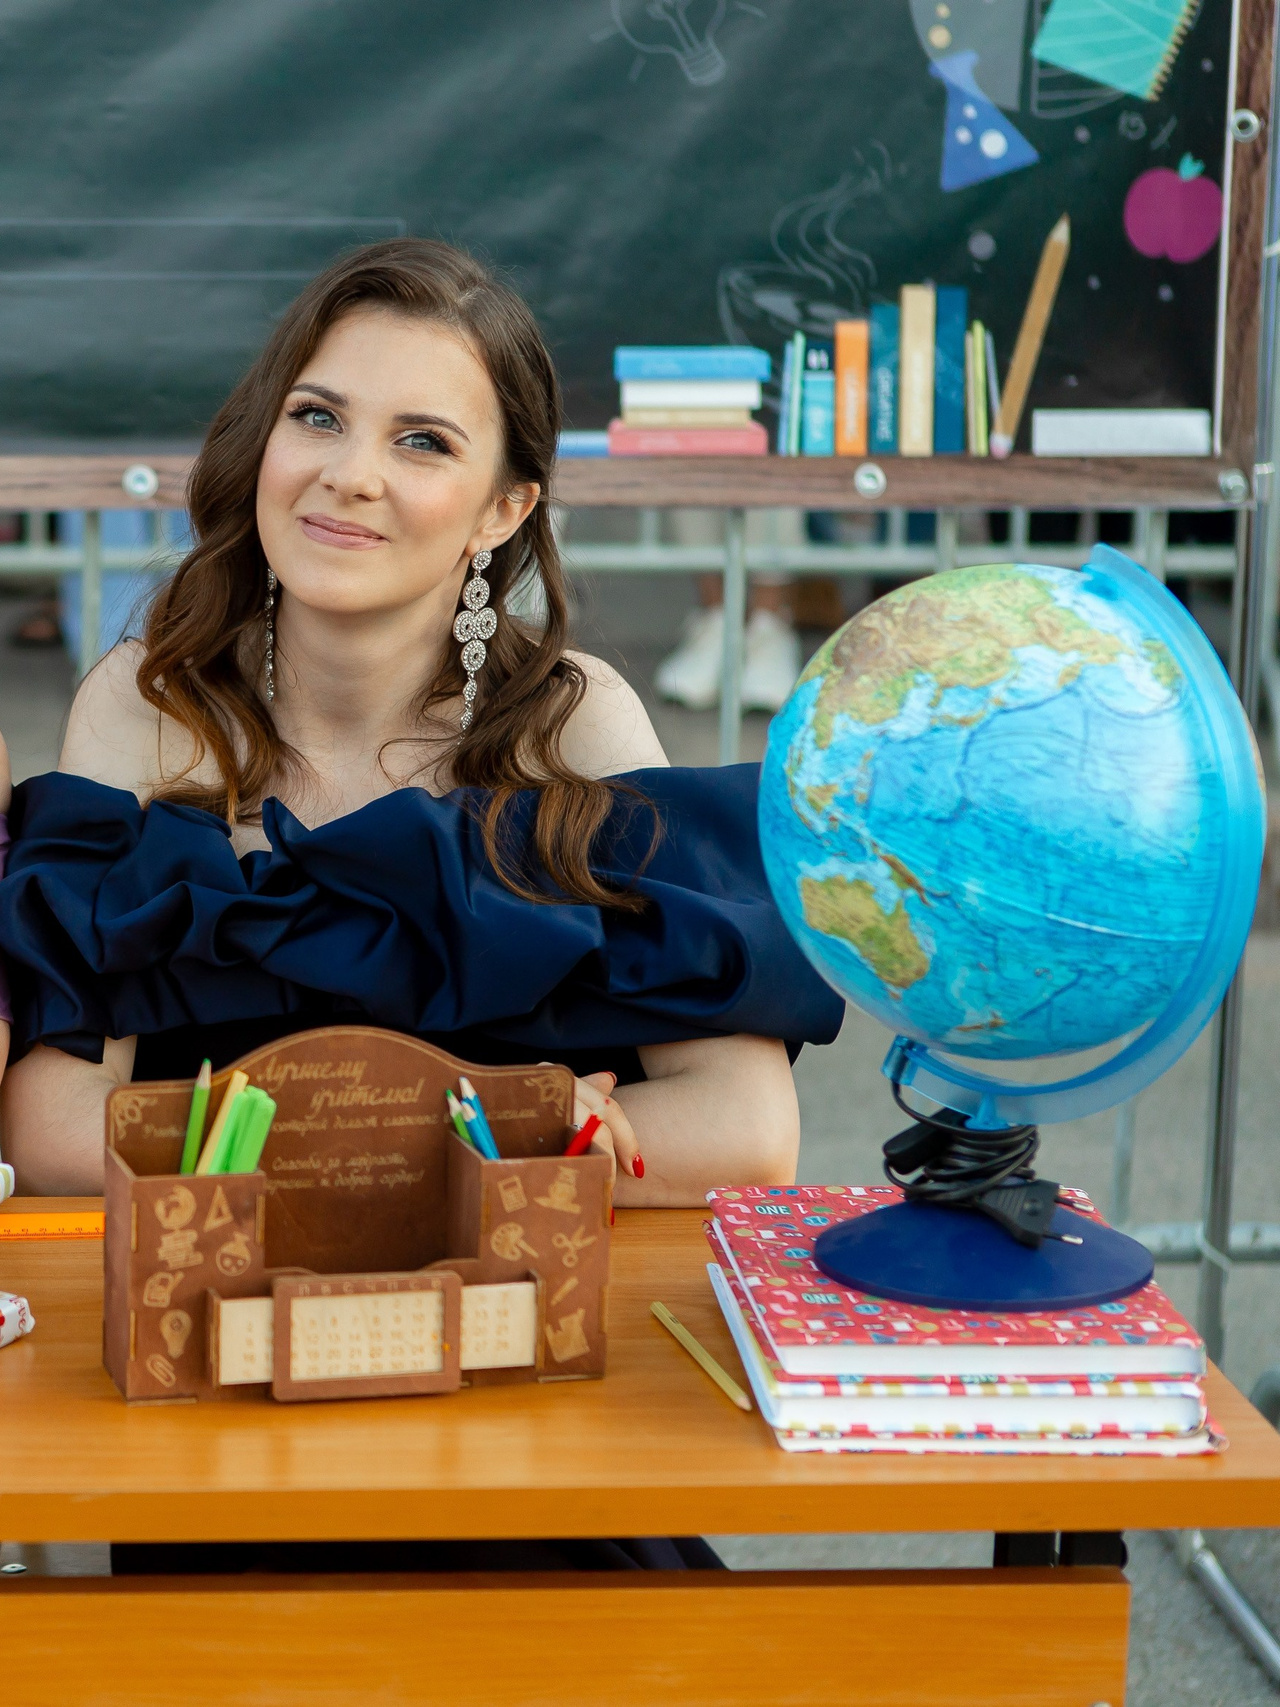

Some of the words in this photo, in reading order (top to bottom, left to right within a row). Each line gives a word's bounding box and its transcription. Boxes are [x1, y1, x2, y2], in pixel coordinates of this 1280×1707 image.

[256, 1055, 368, 1093] Лучшему
[304, 1077, 426, 1120] учителю!
[754, 1205, 791, 1215] ONE
[801, 1293, 842, 1304] ONE
